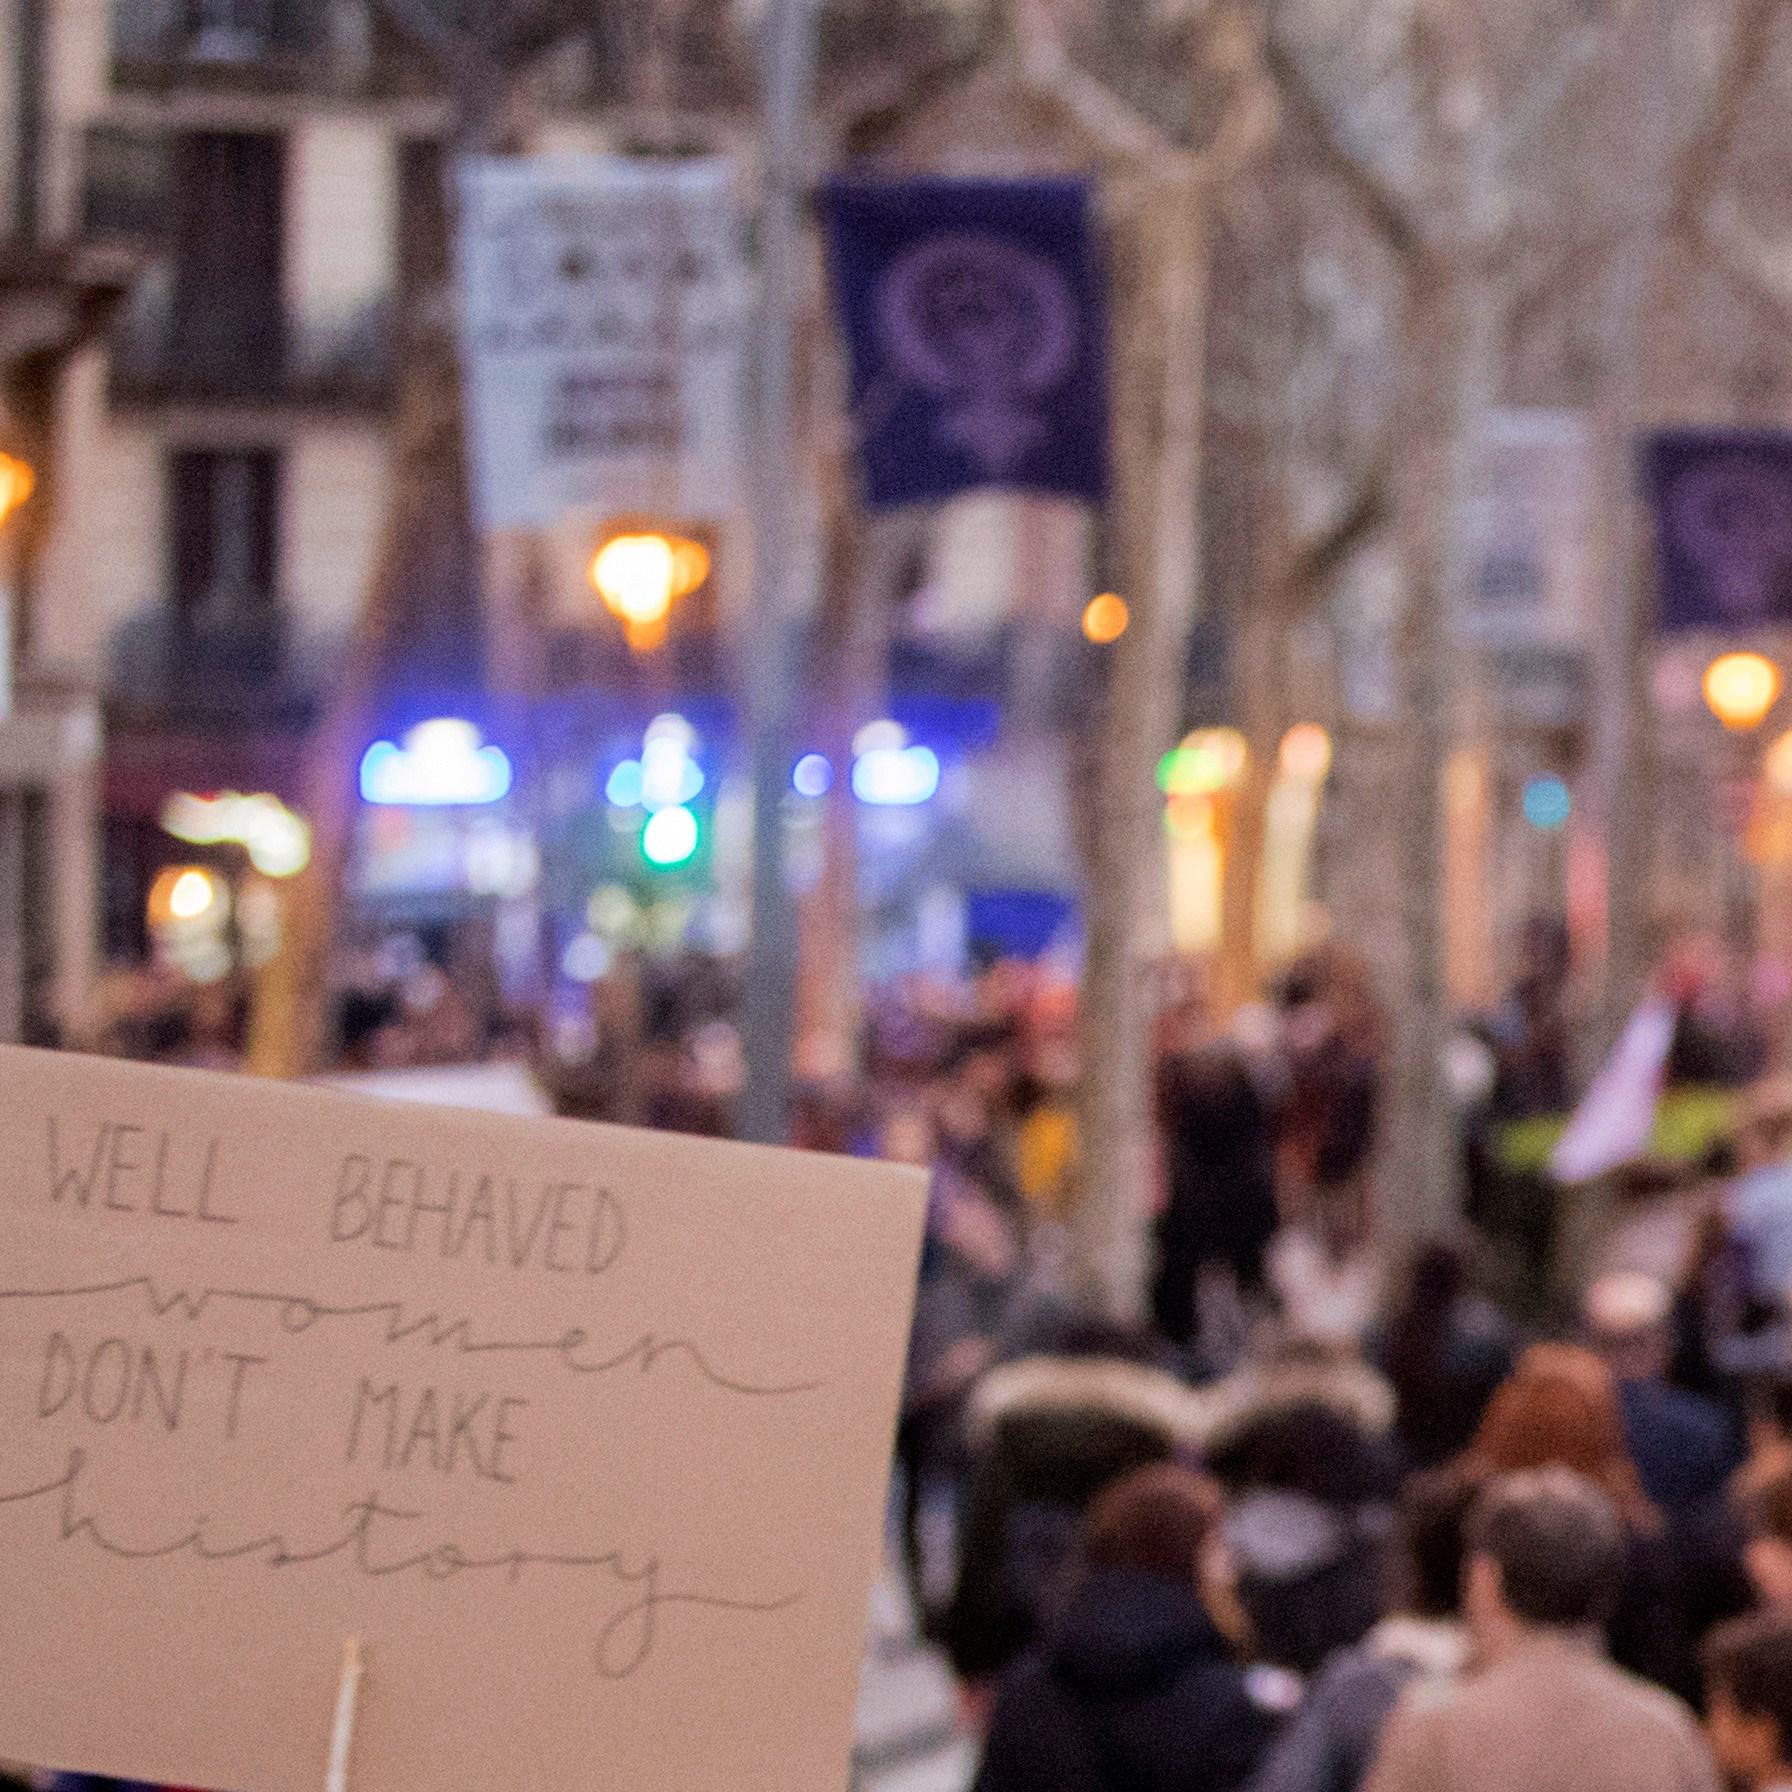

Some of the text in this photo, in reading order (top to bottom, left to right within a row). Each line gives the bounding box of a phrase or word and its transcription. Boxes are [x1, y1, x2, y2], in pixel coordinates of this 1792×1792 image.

[45, 1114, 632, 1274] WELL BEHAVED
[0, 1275, 829, 1396] women
[36, 1330, 532, 1485] DON'T MAKE
[0, 1446, 803, 1680] history
